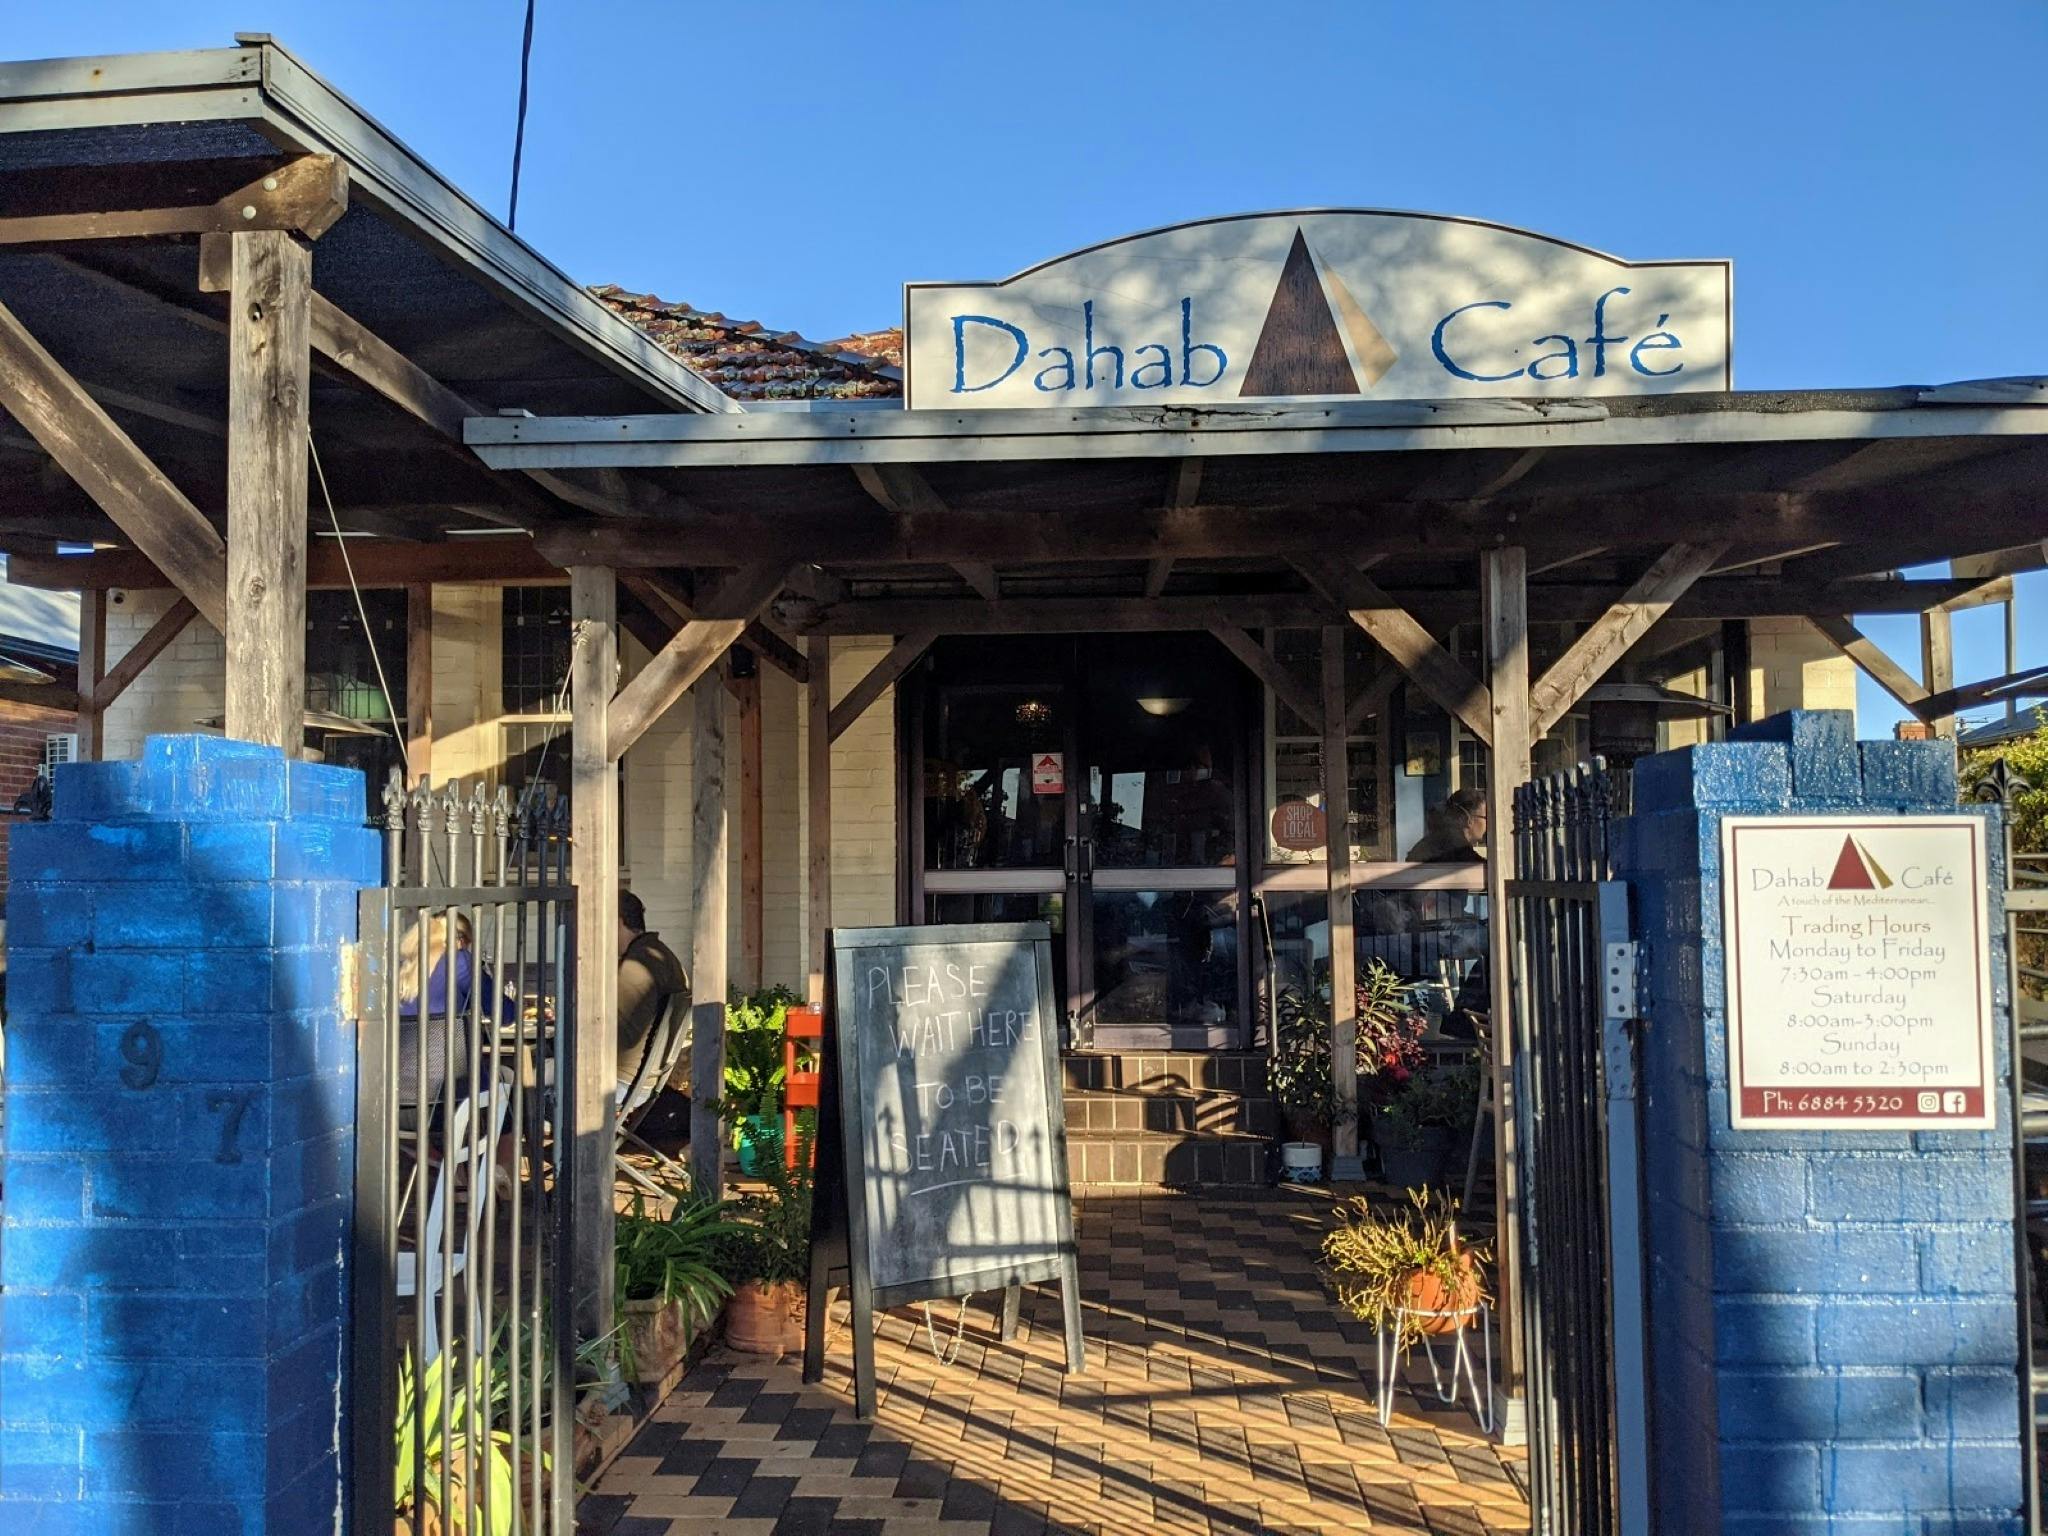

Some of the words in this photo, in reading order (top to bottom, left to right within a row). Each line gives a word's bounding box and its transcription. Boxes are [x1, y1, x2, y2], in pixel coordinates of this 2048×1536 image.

[951, 296, 1227, 394] Dahab
[1432, 287, 1684, 382] Café
[1286, 805, 1313, 821] SHOP
[1283, 820, 1317, 838] LOCAL
[1752, 867, 1824, 891] Dahab
[1901, 866, 1954, 889] Café
[1777, 896, 1791, 907] A
[1835, 895, 1852, 906] the
[1782, 915, 1863, 939] Trading
[1868, 914, 1931, 936] Hours
[1770, 938, 1850, 963] Monday
[1857, 942, 1876, 957] to
[1882, 937, 1946, 964] Friday
[868, 964, 988, 1009] PLEASE
[1780, 966, 1848, 983] 7:30am
[1866, 966, 1936, 988] 4:00pm
[1811, 985, 1907, 1011] Saturday
[889, 1010, 961, 1059] WAIT
[967, 1007, 1033, 1047] HERE
[1820, 1032, 1900, 1058] Sunday
[1779, 1061, 1848, 1075] 8:00am
[1854, 1062, 1872, 1075] to
[1880, 1061, 1949, 1082] 2:30pm
[913, 1081, 954, 1117] TO
[965, 1075, 1005, 1105] BE
[1763, 1090, 1793, 1113] Ph:
[1798, 1094, 1848, 1112] 6884
[1853, 1096, 1903, 1113] 5320
[891, 1119, 1020, 1173] SEATED
